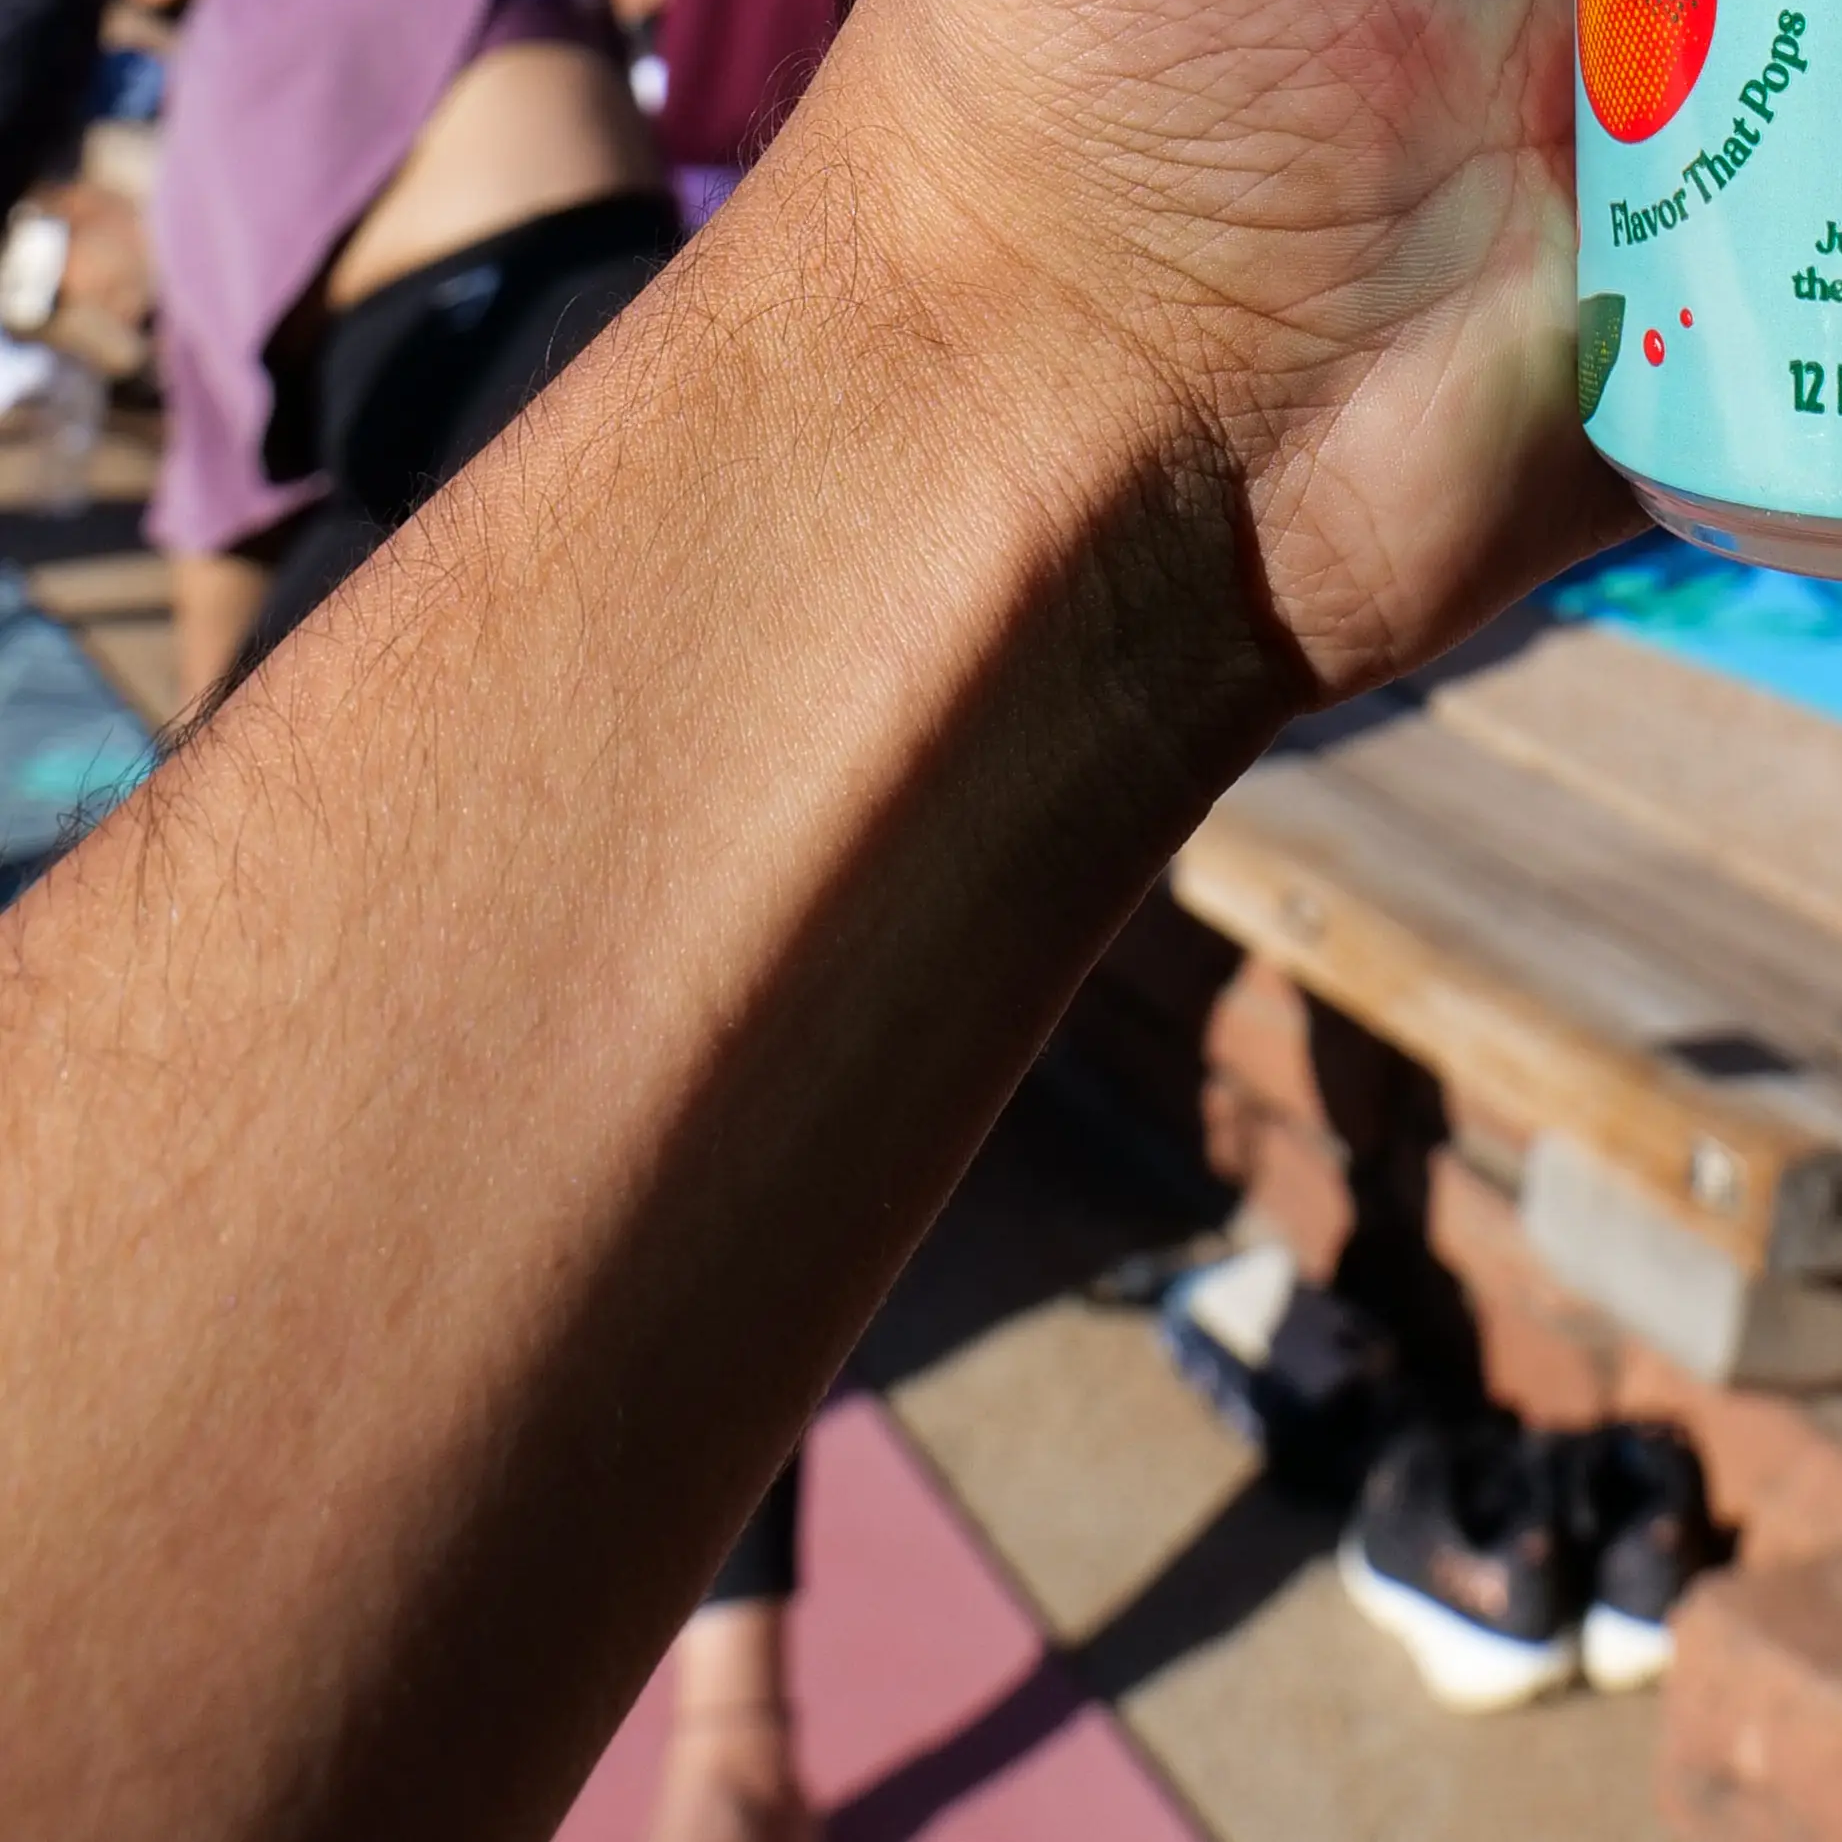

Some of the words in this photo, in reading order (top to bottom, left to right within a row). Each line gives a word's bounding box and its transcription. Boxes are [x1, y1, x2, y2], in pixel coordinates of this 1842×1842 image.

[1609, 187, 1690, 248] Flavor
[1681, 115, 1761, 205] That
[1738, 8, 1809, 125] Pops
[1788, 359, 1825, 414] 12
